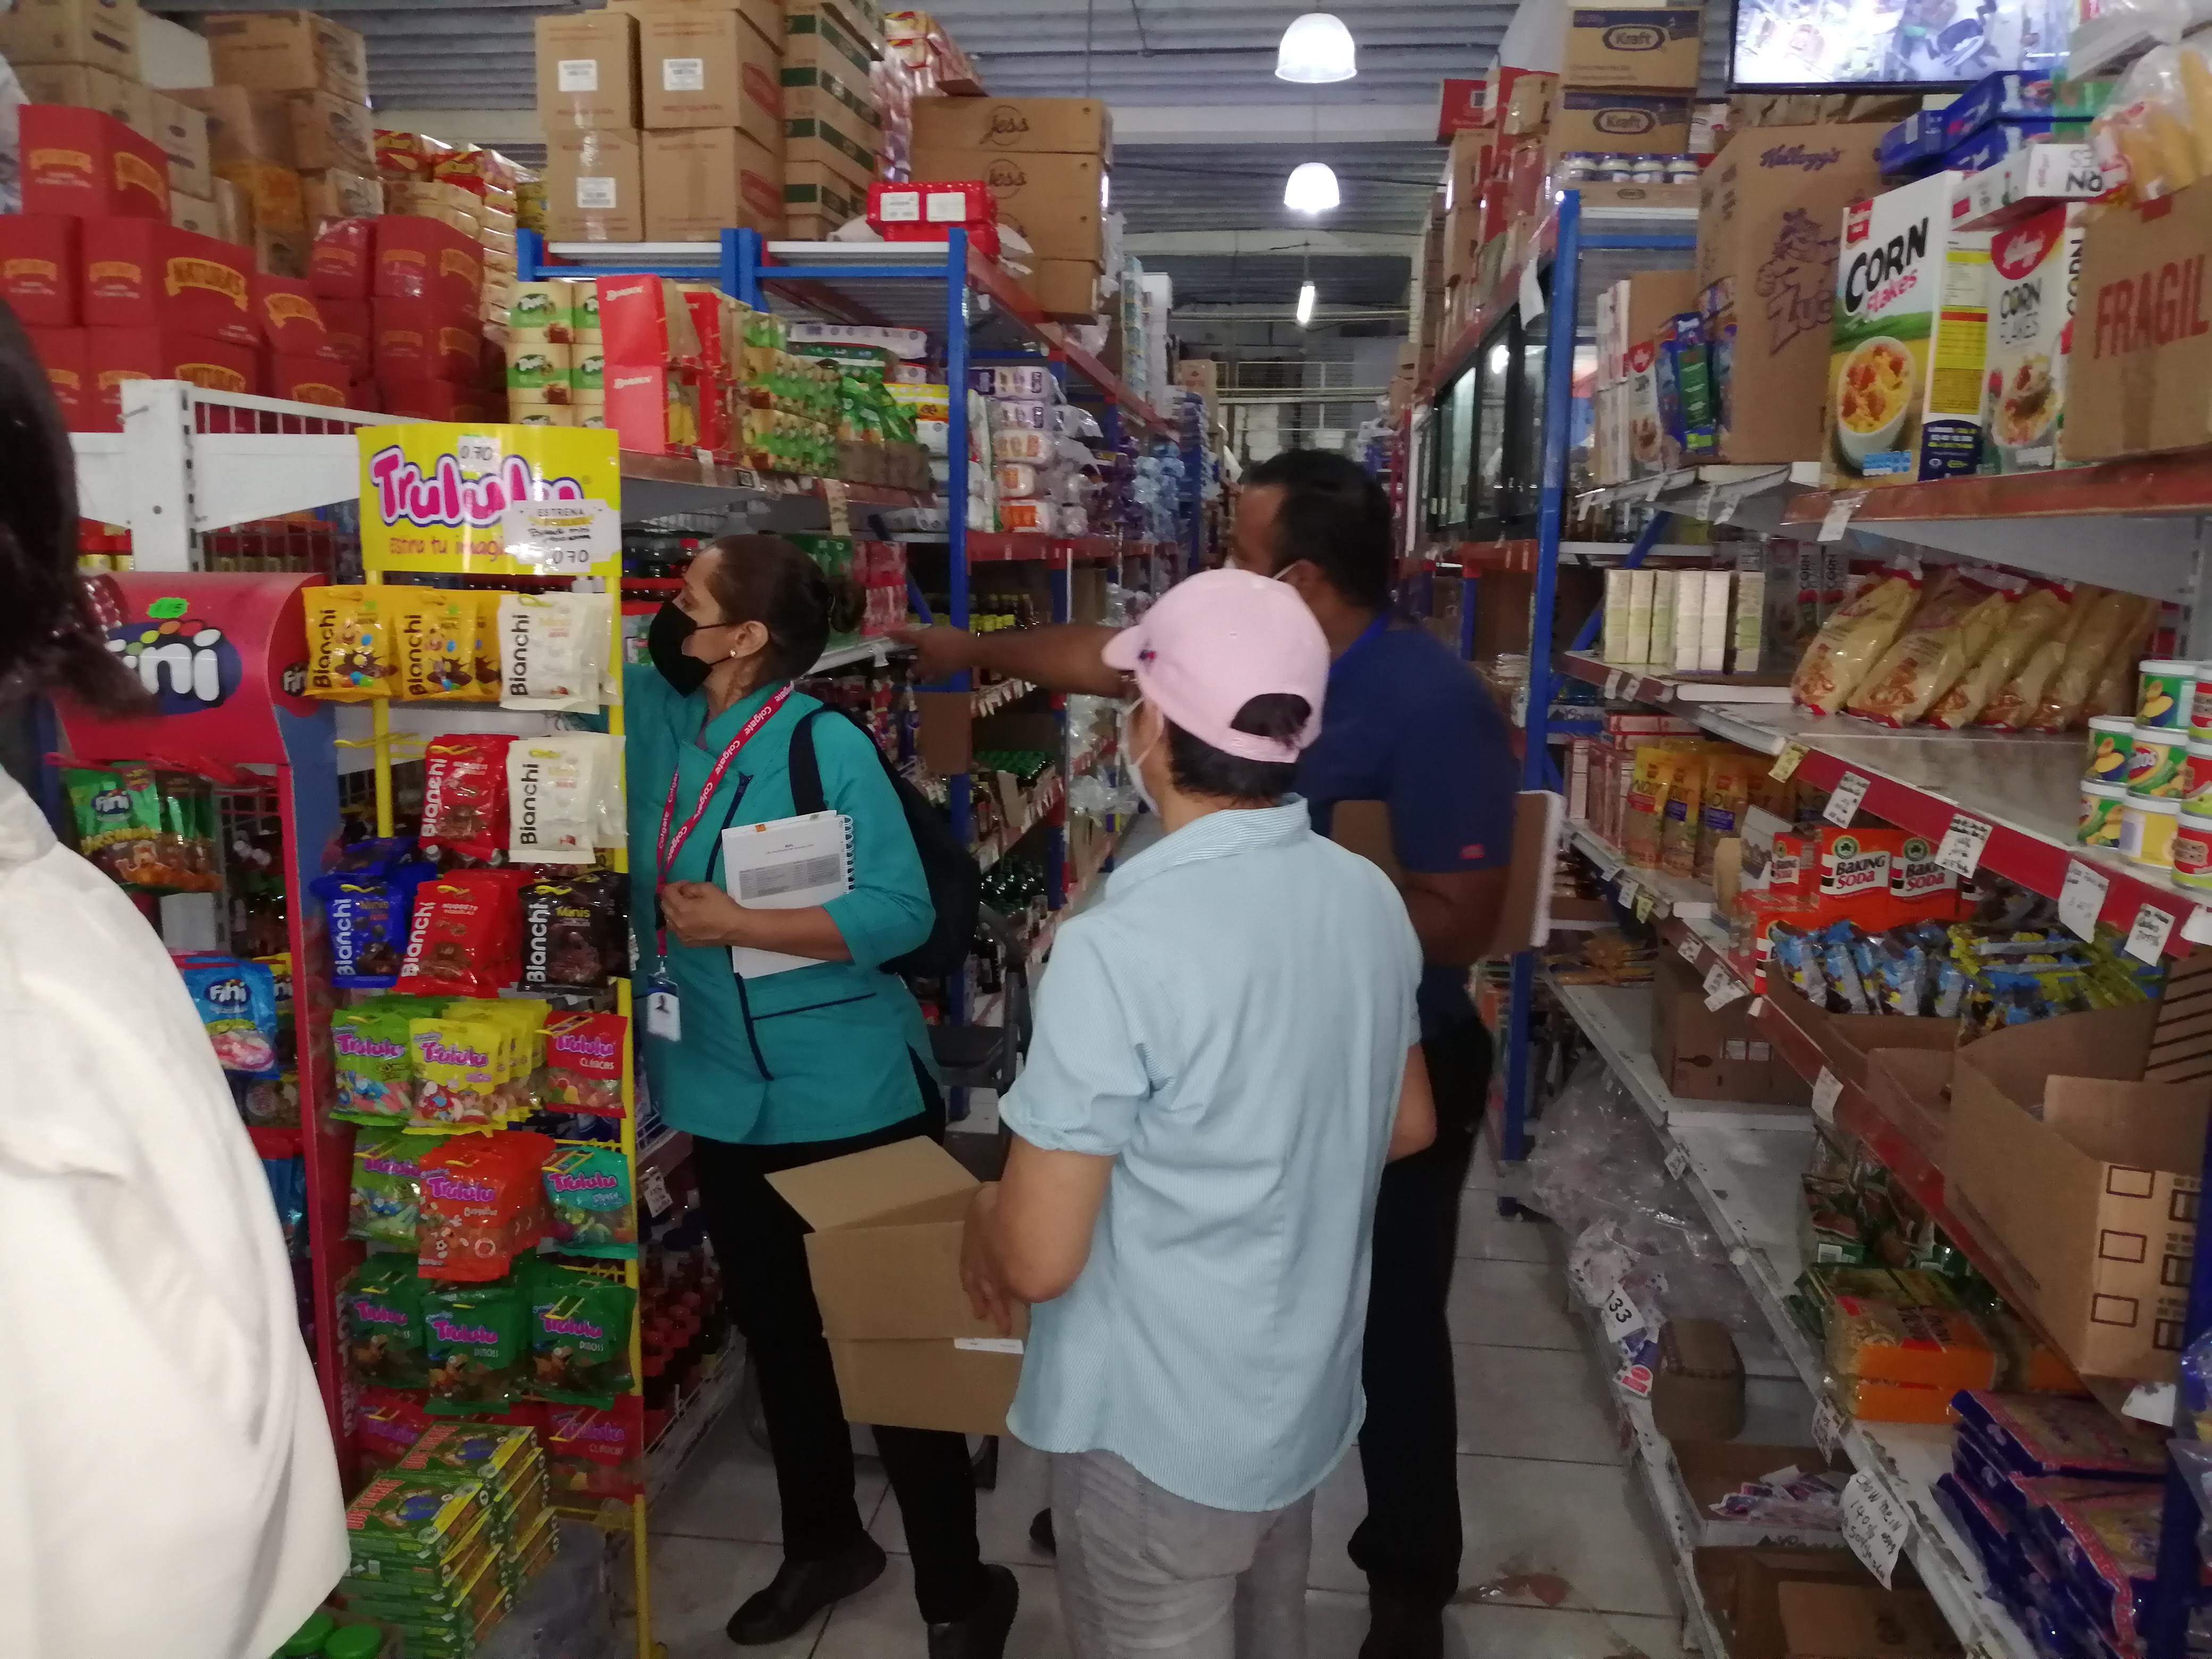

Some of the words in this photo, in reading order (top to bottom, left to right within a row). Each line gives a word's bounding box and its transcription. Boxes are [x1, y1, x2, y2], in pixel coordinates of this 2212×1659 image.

[1845, 216, 1929, 313] CORN
[2093, 254, 2209, 360] FRAGIL
[312, 609, 337, 688] Bianchi
[404, 615, 429, 696] Bianchi
[509, 614, 530, 696] Bianchi
[715, 740, 741, 775] Colgate
[744, 706, 772, 736] Colgate
[520, 764, 540, 844] Bianchi
[332, 898, 356, 976] Bianchi
[400, 902, 437, 977] Bianchi
[526, 902, 550, 983] Bianchi
[419, 1040, 489, 1068] Trululu
[426, 1176, 496, 1203] Trululu
[546, 1169, 618, 1193] Trululu
[1605, 1289, 1633, 1323] 133
